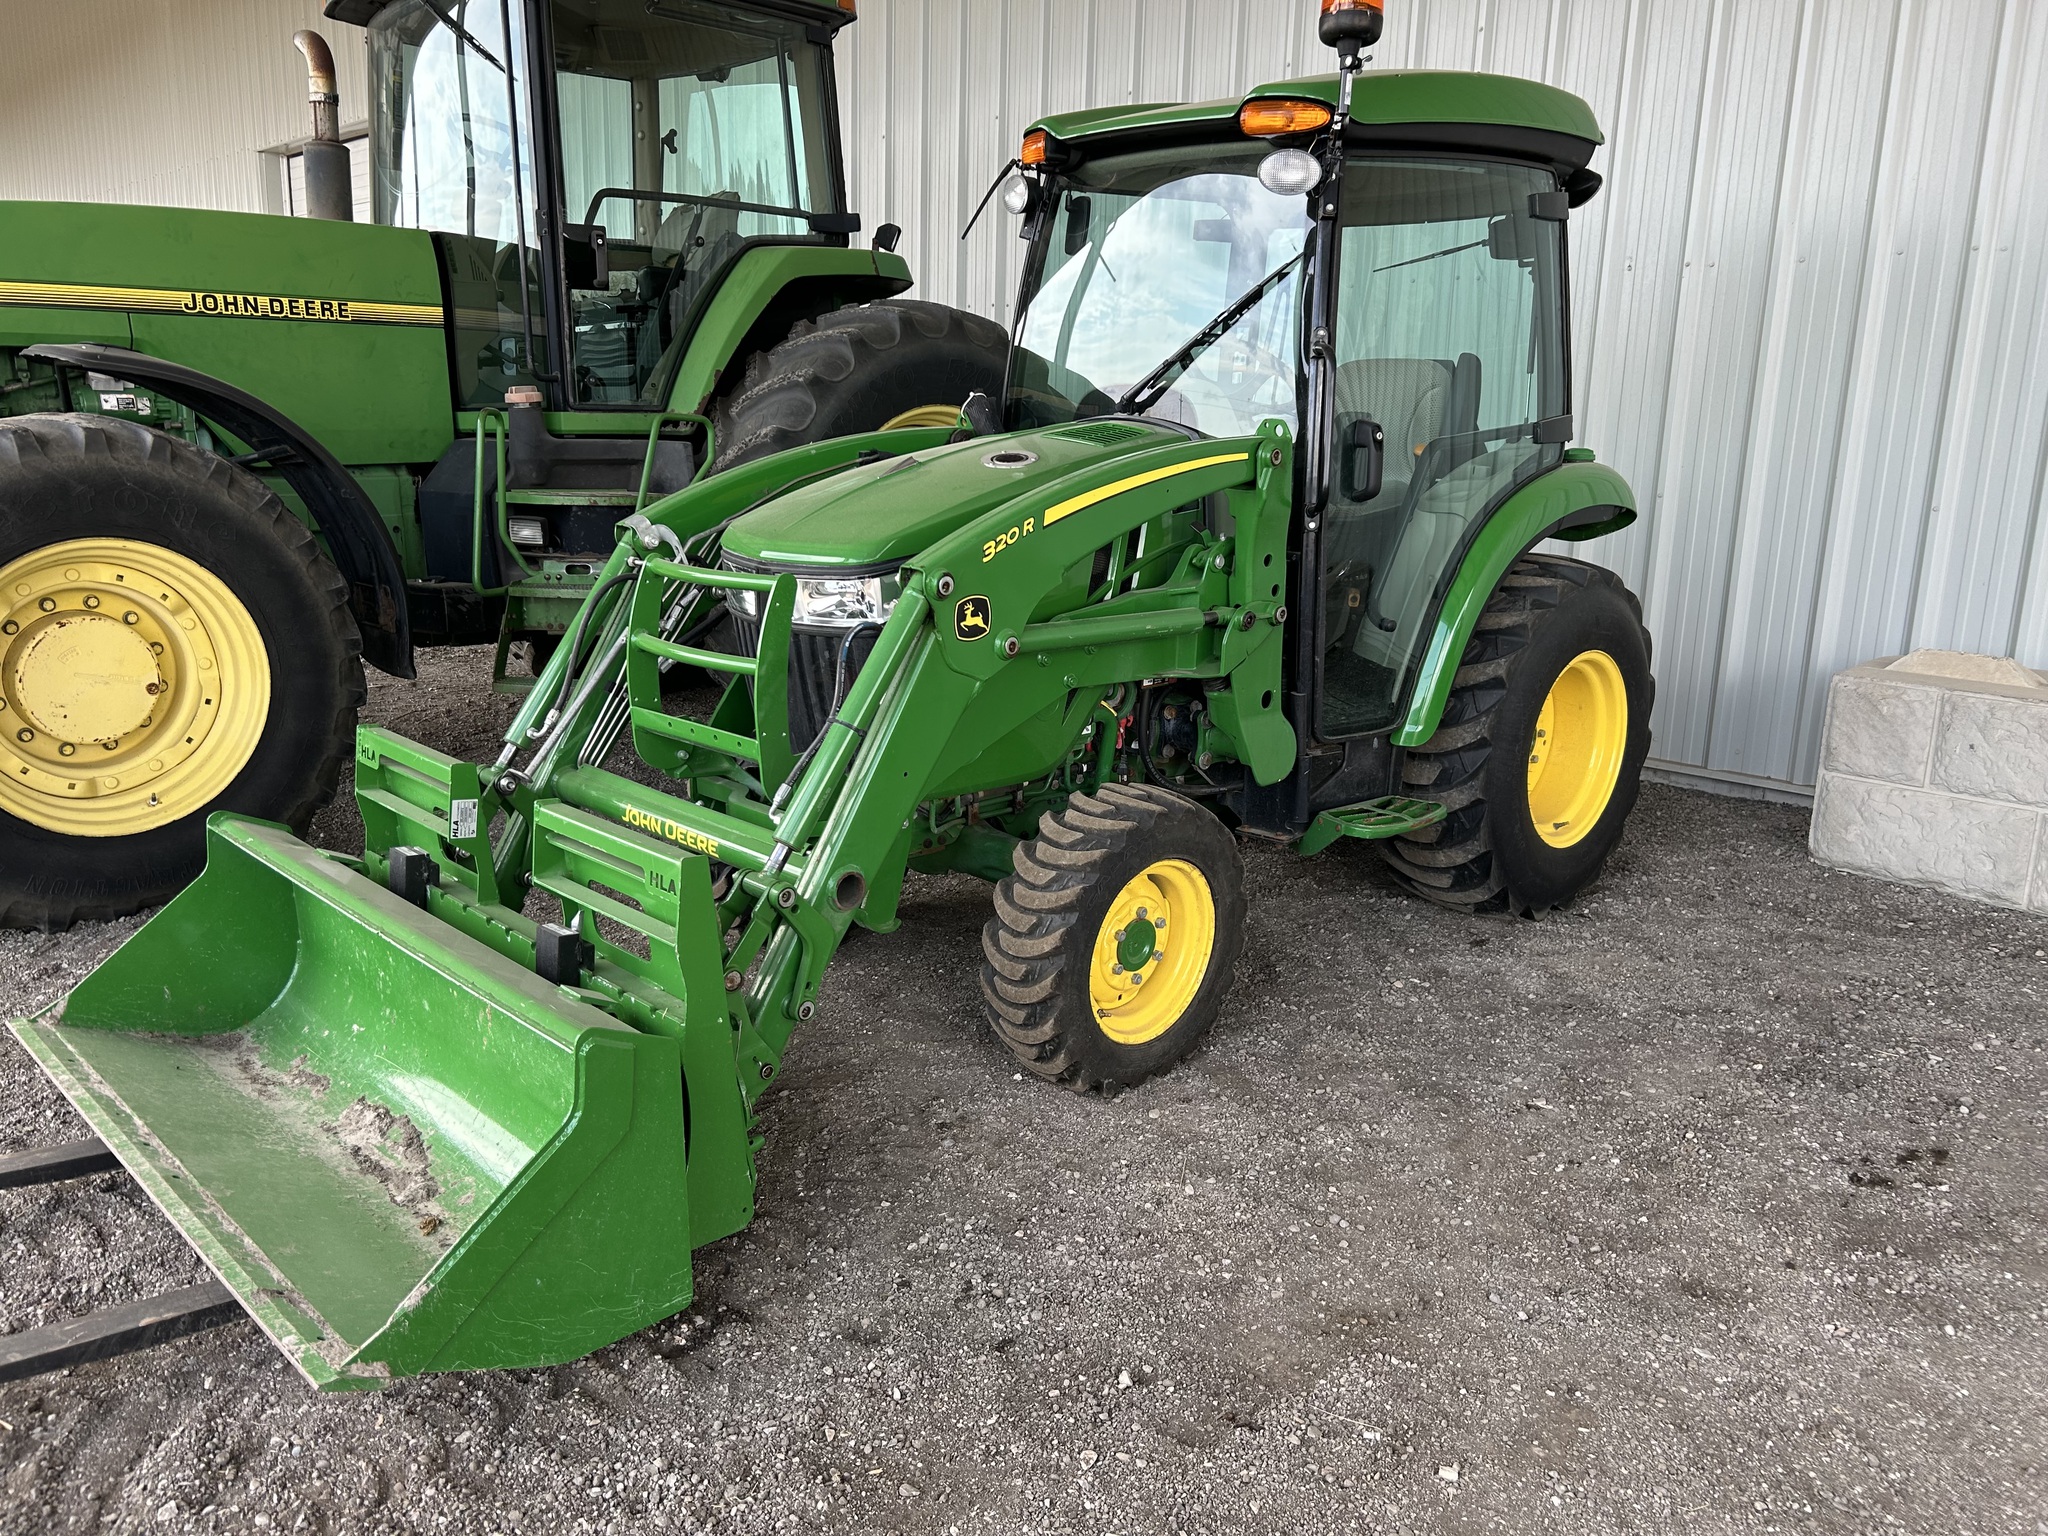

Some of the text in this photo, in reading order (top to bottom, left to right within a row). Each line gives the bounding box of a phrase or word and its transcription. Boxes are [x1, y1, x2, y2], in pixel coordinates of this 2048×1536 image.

[183, 292, 351, 320] JOHN DEERE
[982, 516, 1036, 563] 320 R
[361, 744, 377, 764] HLA
[452, 820, 460, 838] HLA
[621, 803, 720, 859] JOHN DEERE
[649, 870, 678, 897] HLA
